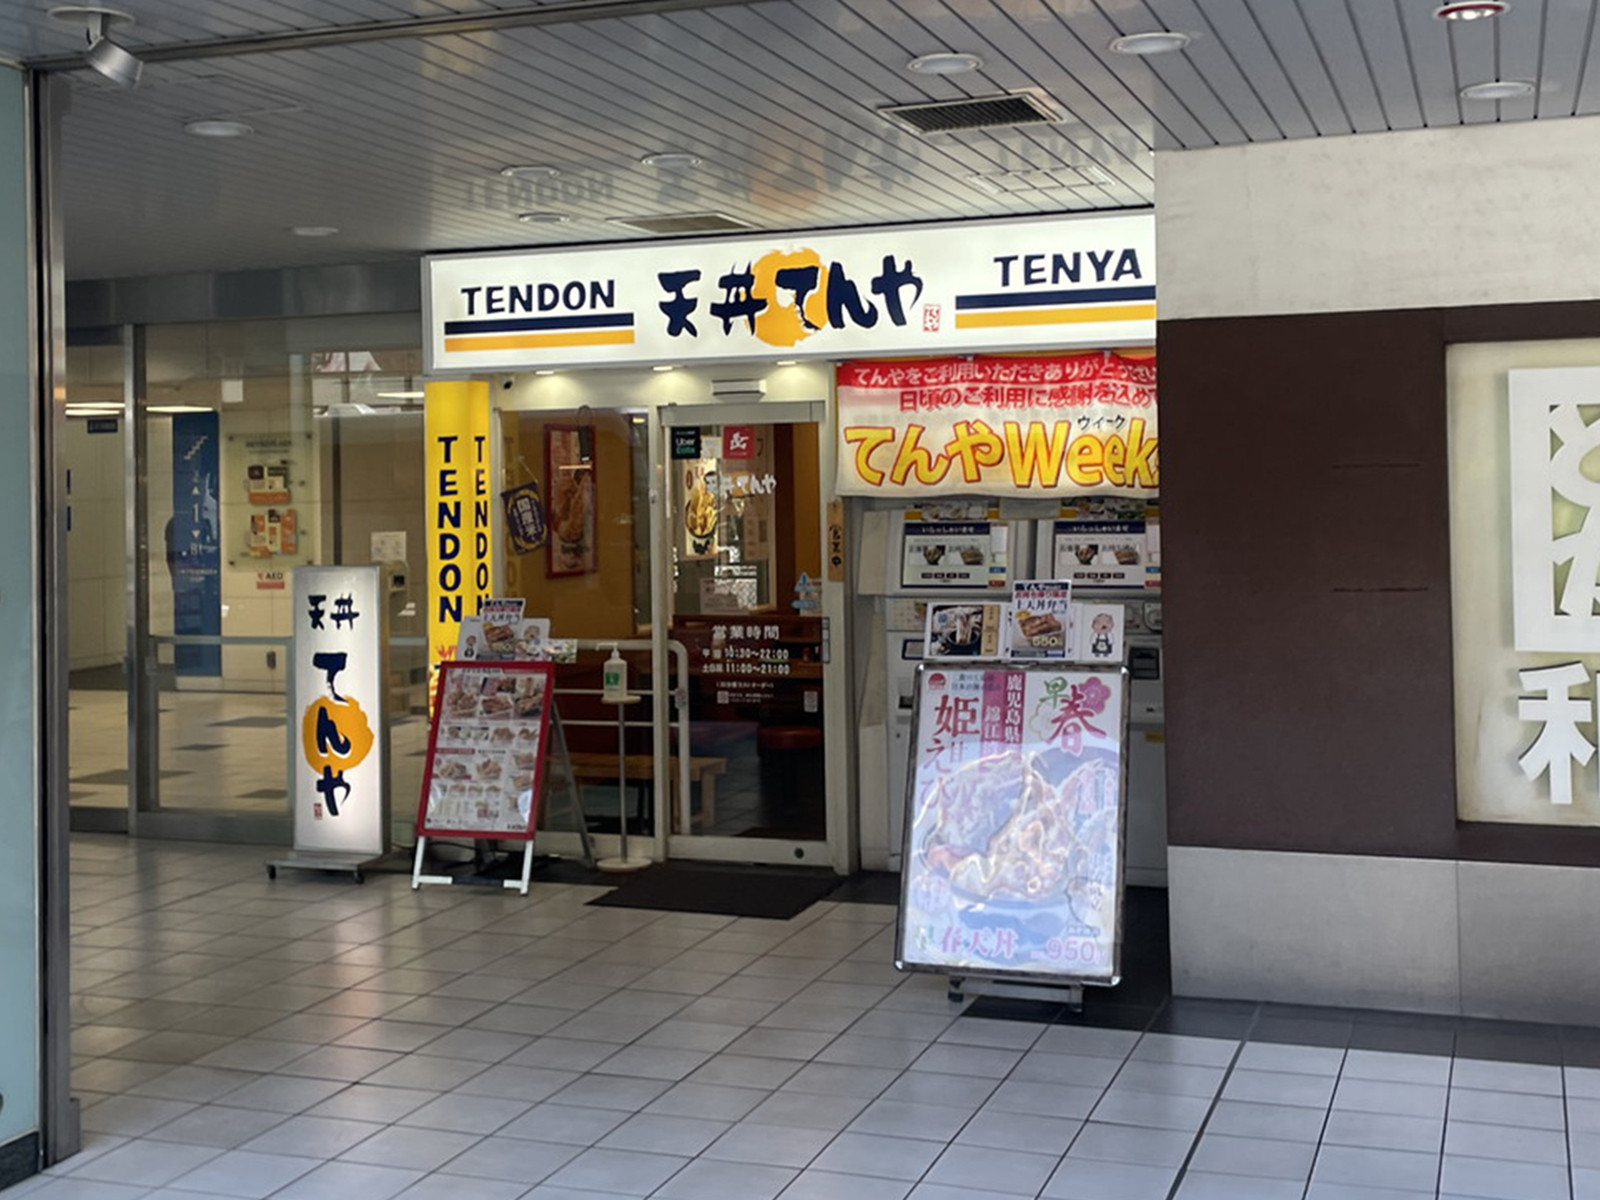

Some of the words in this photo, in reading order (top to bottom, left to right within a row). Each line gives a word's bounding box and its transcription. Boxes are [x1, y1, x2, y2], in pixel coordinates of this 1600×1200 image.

[993, 248, 1143, 288] TENYA
[460, 279, 615, 316] TENDON
[1076, 414, 1126, 430] ウィーク
[437, 436, 463, 624] TENDON
[308, 592, 360, 632] 天丼
[711, 624, 780, 640] 営業時間
[312, 652, 351, 817] てんや
